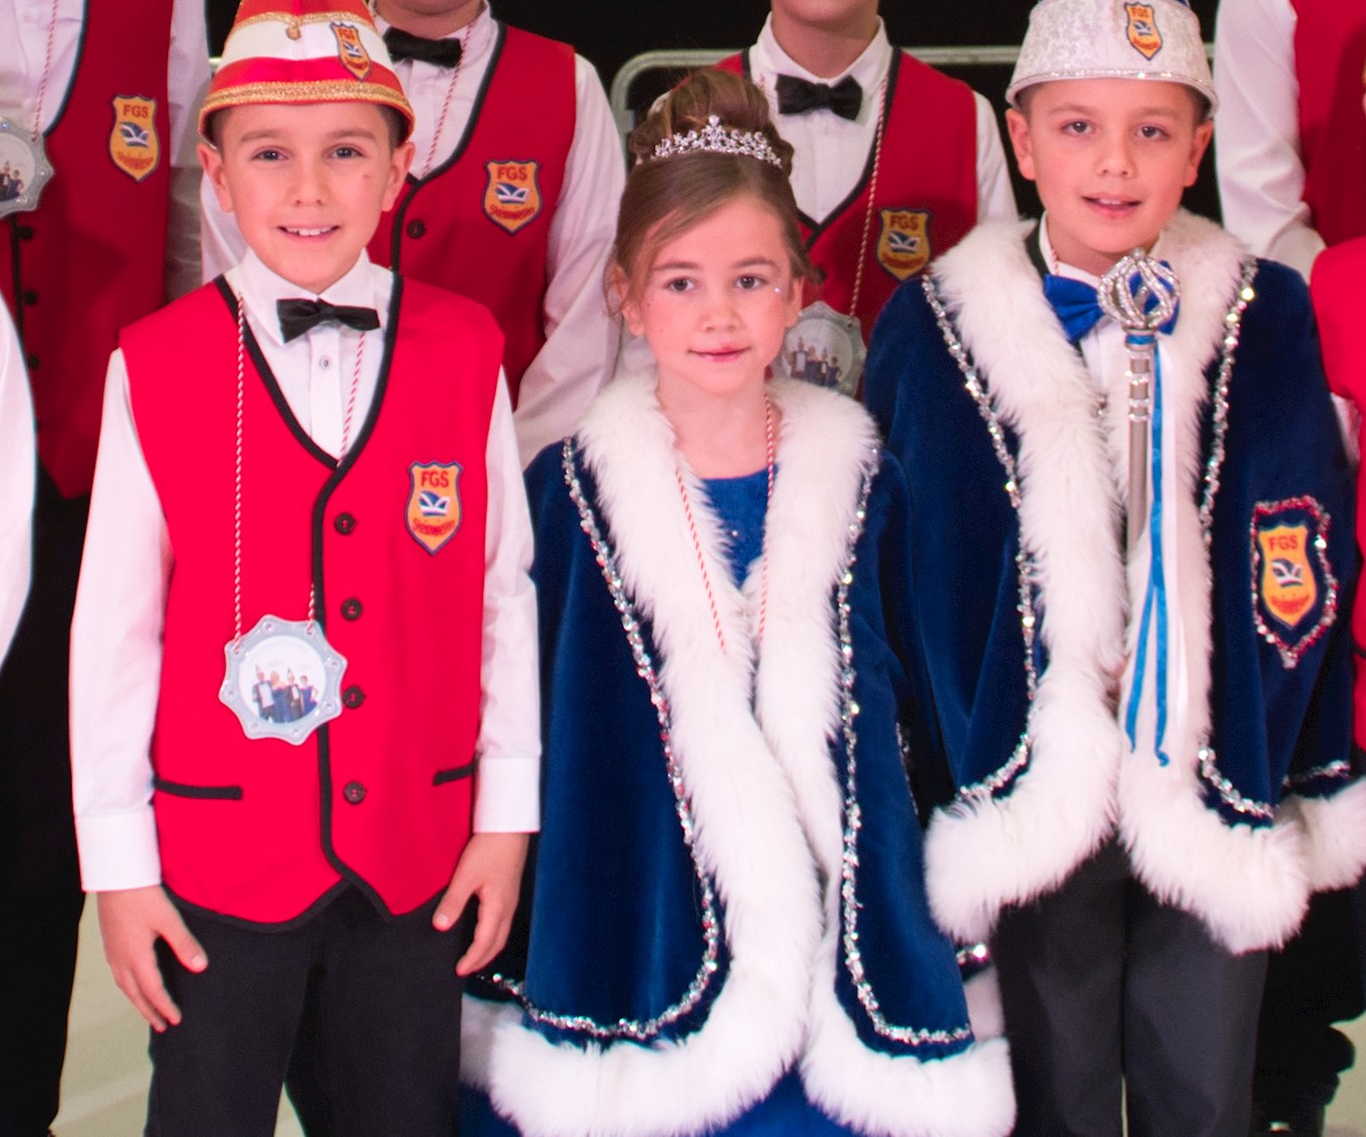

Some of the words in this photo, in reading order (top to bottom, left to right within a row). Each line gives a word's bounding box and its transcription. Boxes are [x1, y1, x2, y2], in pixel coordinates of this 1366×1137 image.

[122, 104, 149, 119] FGS
[496, 165, 529, 181] FGS
[889, 215, 919, 231] FGS
[420, 469, 450, 488] FGS
[1268, 534, 1299, 551] FGS
